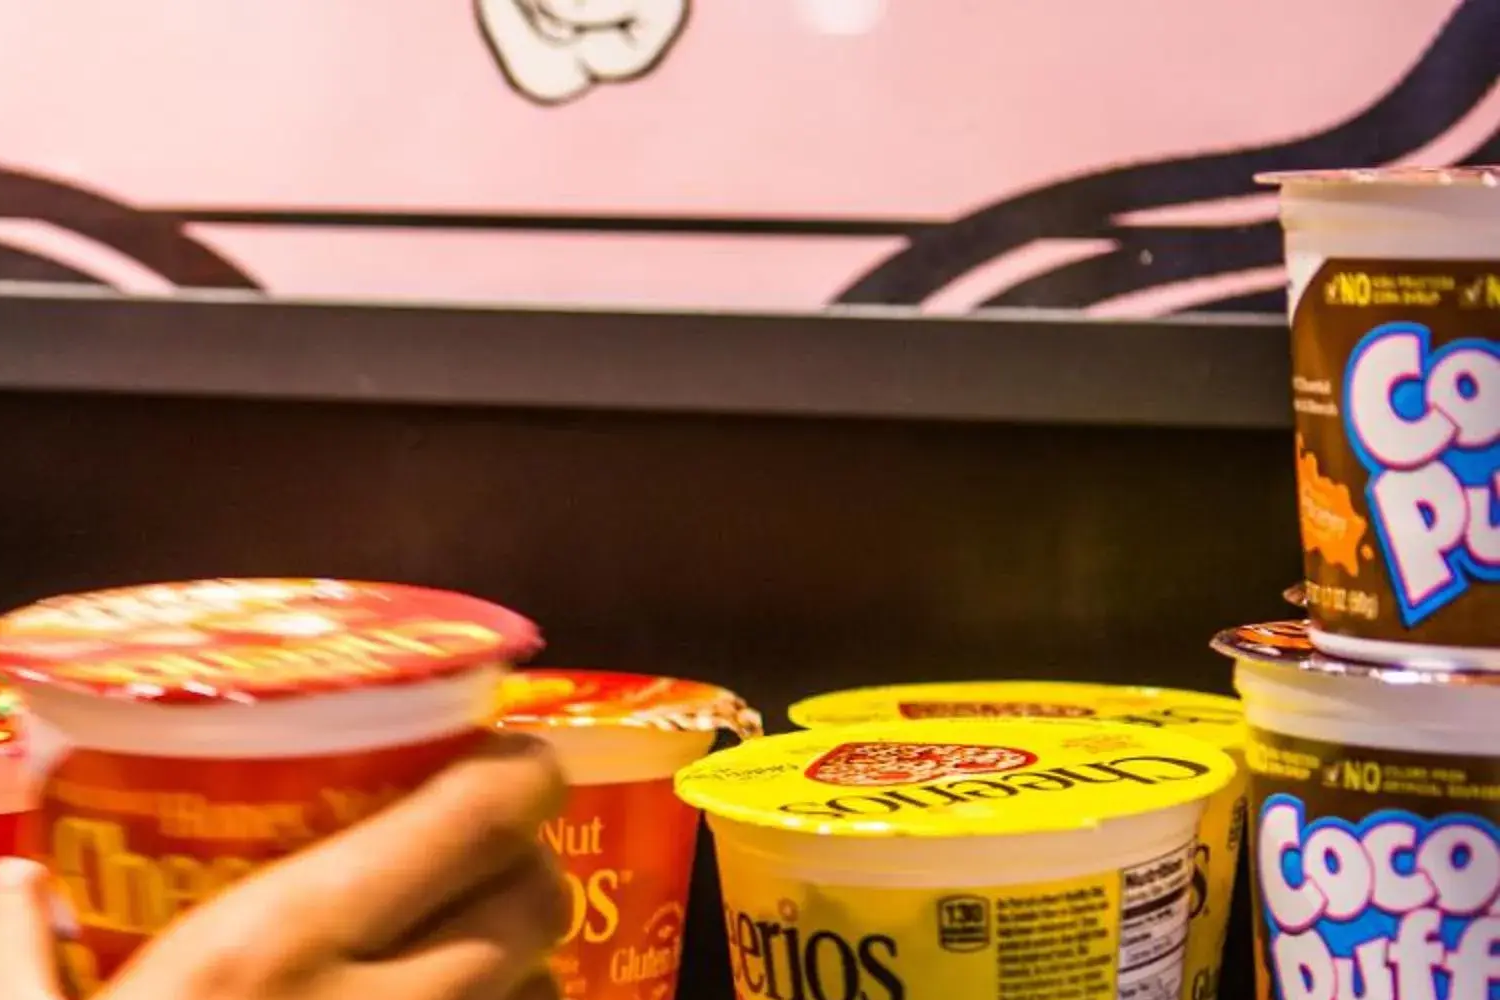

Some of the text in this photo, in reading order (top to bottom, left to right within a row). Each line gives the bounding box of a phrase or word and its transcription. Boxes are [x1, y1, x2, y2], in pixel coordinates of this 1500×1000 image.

[1339, 271, 1372, 307] NO
[1343, 760, 1382, 794] NO
[538, 814, 605, 857] Nut
